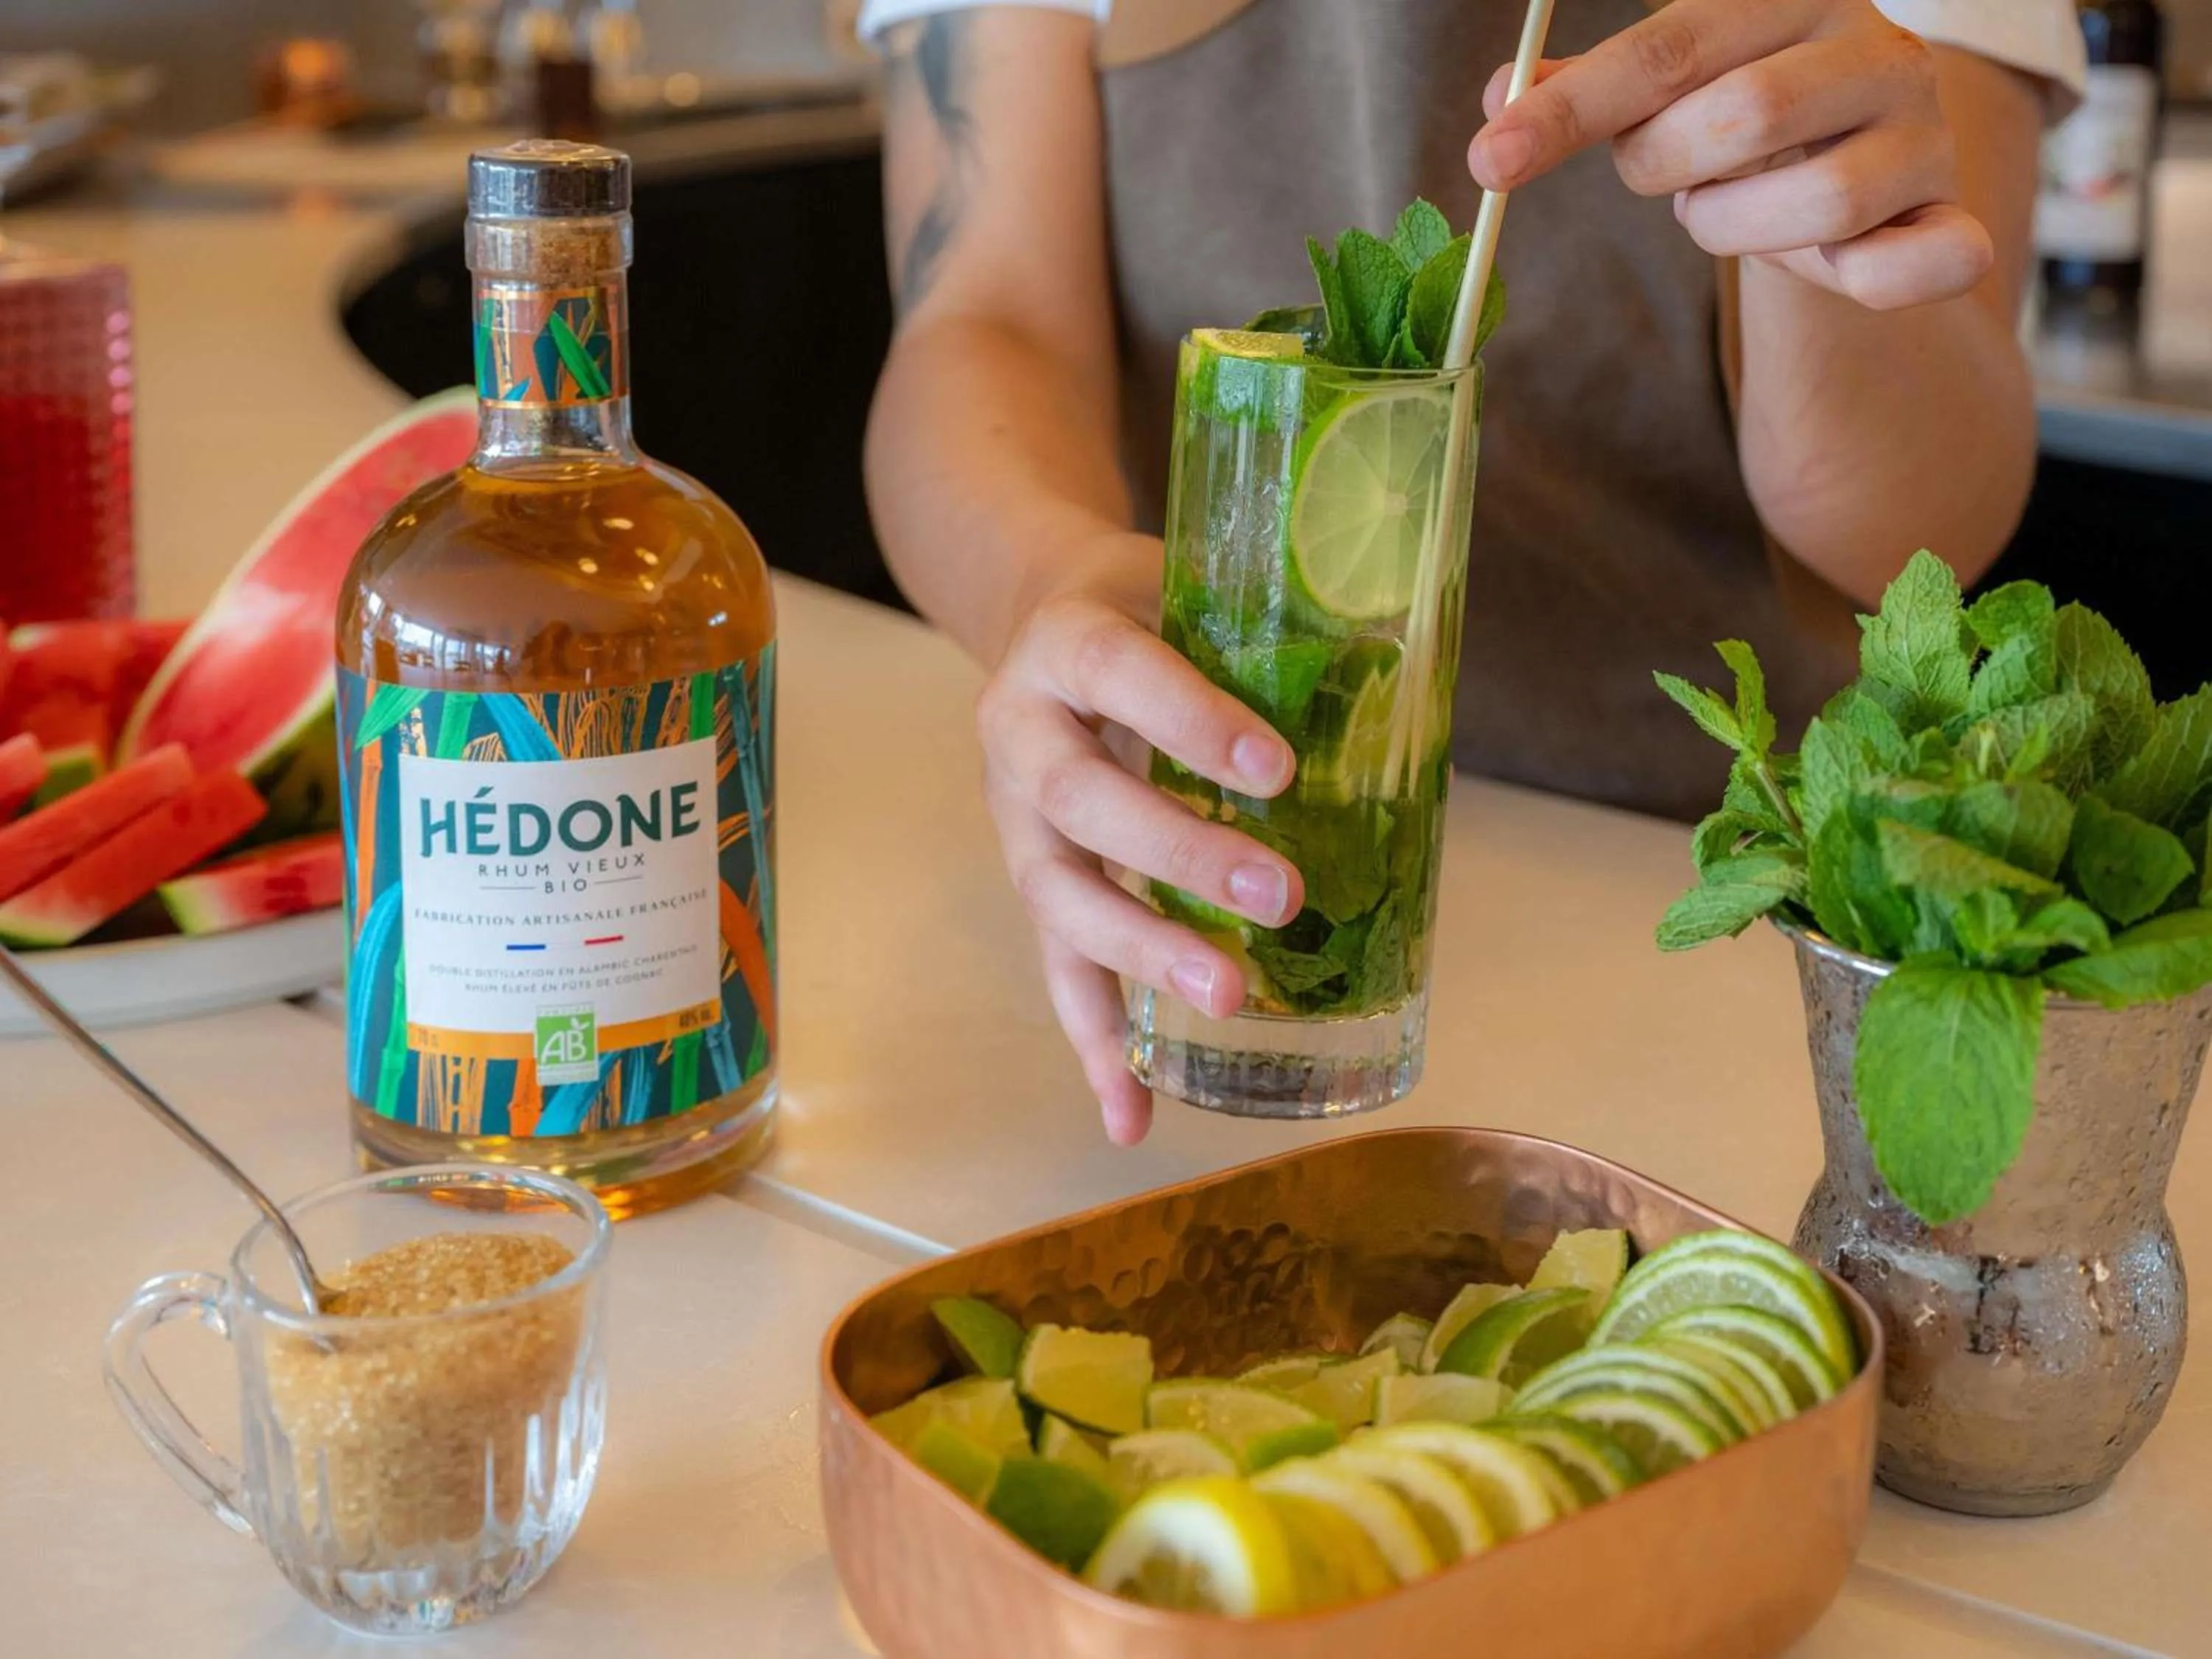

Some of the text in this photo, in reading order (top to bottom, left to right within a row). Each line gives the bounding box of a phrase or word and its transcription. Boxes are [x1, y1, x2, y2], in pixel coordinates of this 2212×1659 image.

[420, 781, 701, 858] HÉDONE
[479, 853, 645, 877] RHUM VIEUX
[544, 879, 587, 894] BIO
[414, 888, 708, 926] FABRICATION ARTISANALE FRANÇAISE
[475, 967, 554, 978] DISTILLATION
